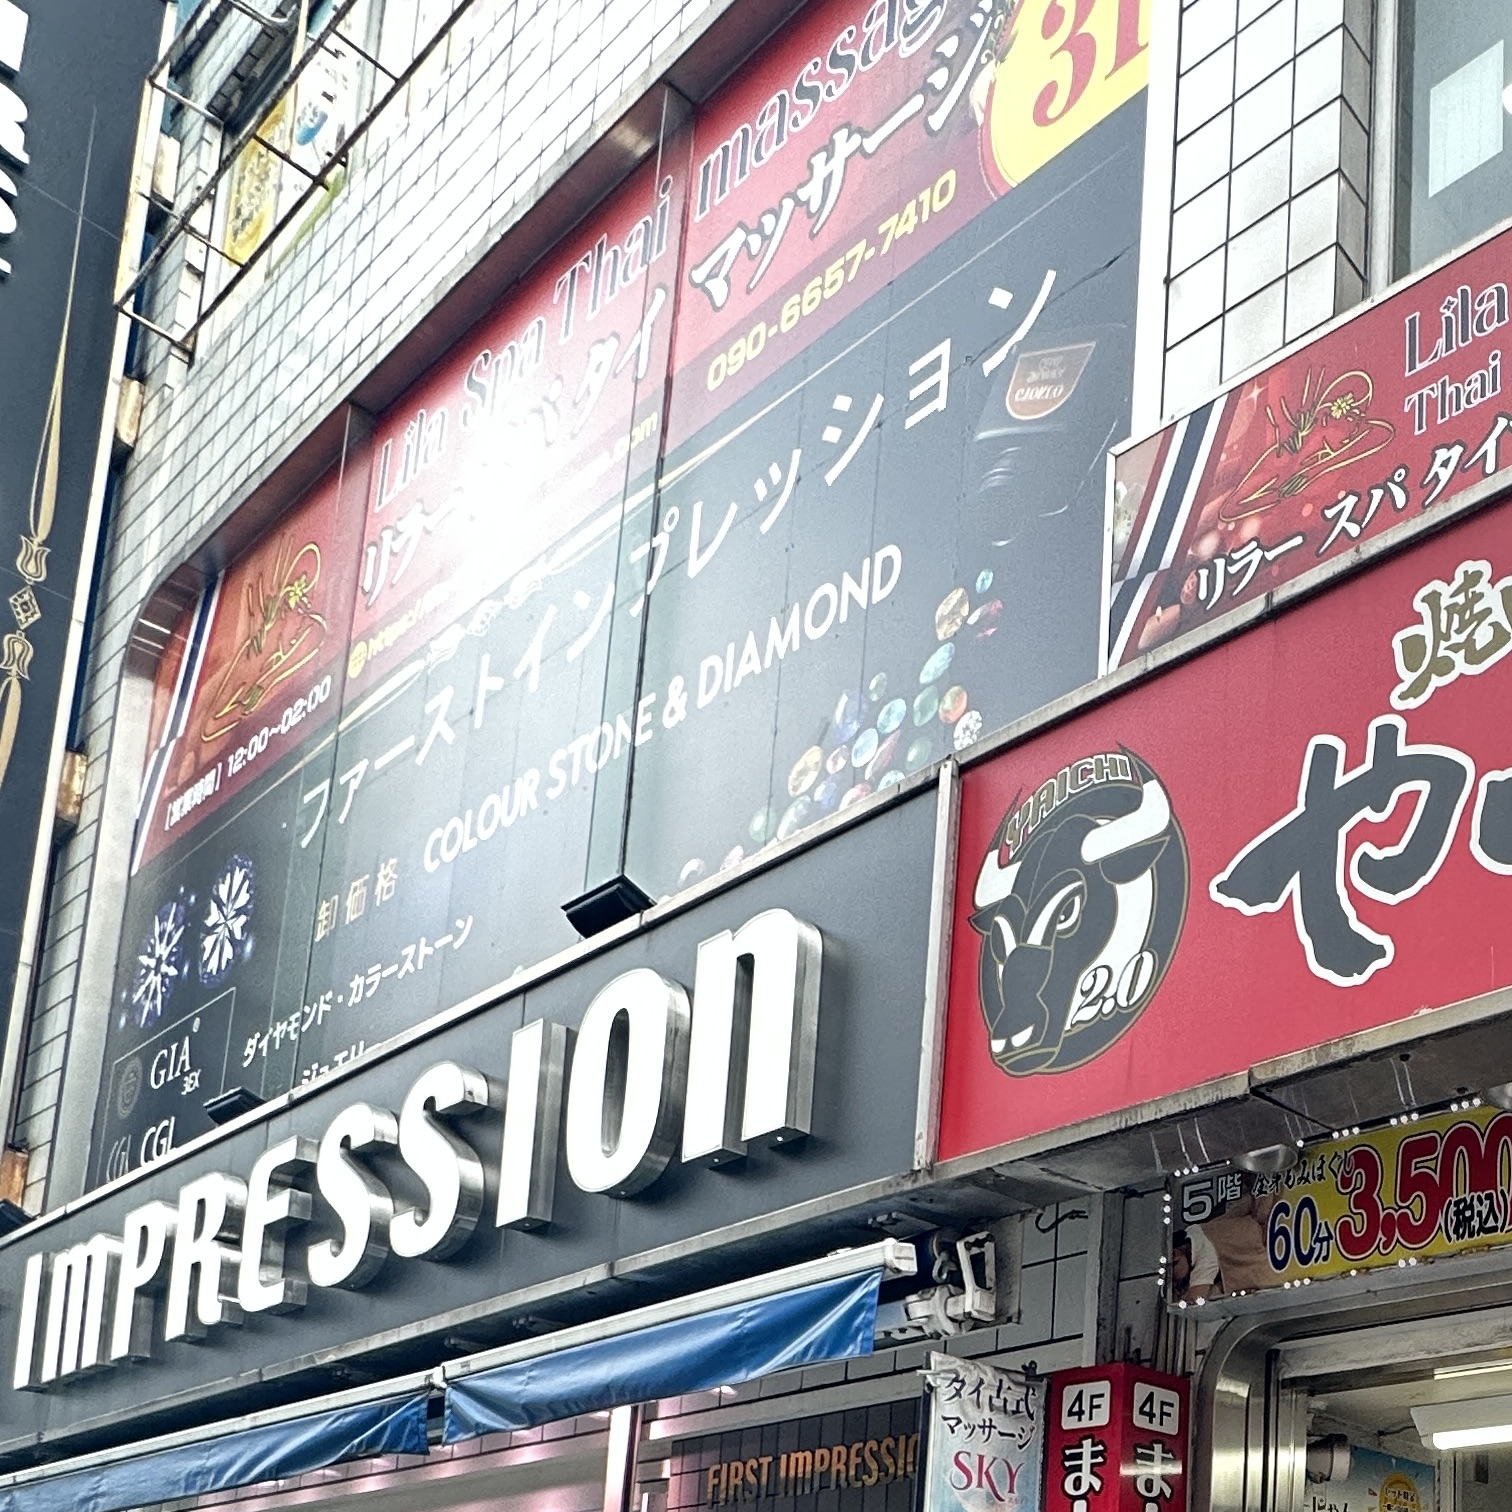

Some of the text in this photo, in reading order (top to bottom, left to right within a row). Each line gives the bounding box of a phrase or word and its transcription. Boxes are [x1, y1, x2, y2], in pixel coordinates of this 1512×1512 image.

[690, 0, 991, 312] マッサージ
[553, 176, 673, 344] Thai
[706, 168, 957, 392] 090-6657-7410
[1402, 276, 1509, 377] Lila
[1403, 350, 1503, 436] Thai
[301, 269, 1057, 848] ファーストインプレッション
[1196, 531, 1305, 612] リラー
[1318, 464, 1411, 556] スパ
[424, 544, 903, 874] COLOUR STONE & DIAMOND
[1003, 749, 1134, 862] YAICHI
[314, 858, 399, 944] 卸価格
[242, 915, 475, 1068] ダイヤモンド・カラーストーン
[1068, 950, 1158, 1032] 2.0
[150, 1036, 191, 1090] GIA
[1182, 1173, 1243, 1224] 5階
[1267, 1196, 1335, 1273] 60分
[1443, 1187, 1511, 1244] (税込)
[941, 1414, 1035, 1450] マッサージ
[1065, 1388, 1106, 1421] 4F
[1138, 1390, 1175, 1426] 4F
[706, 1456, 772, 1505] FIRST
[950, 1450, 1025, 1502] SKY
